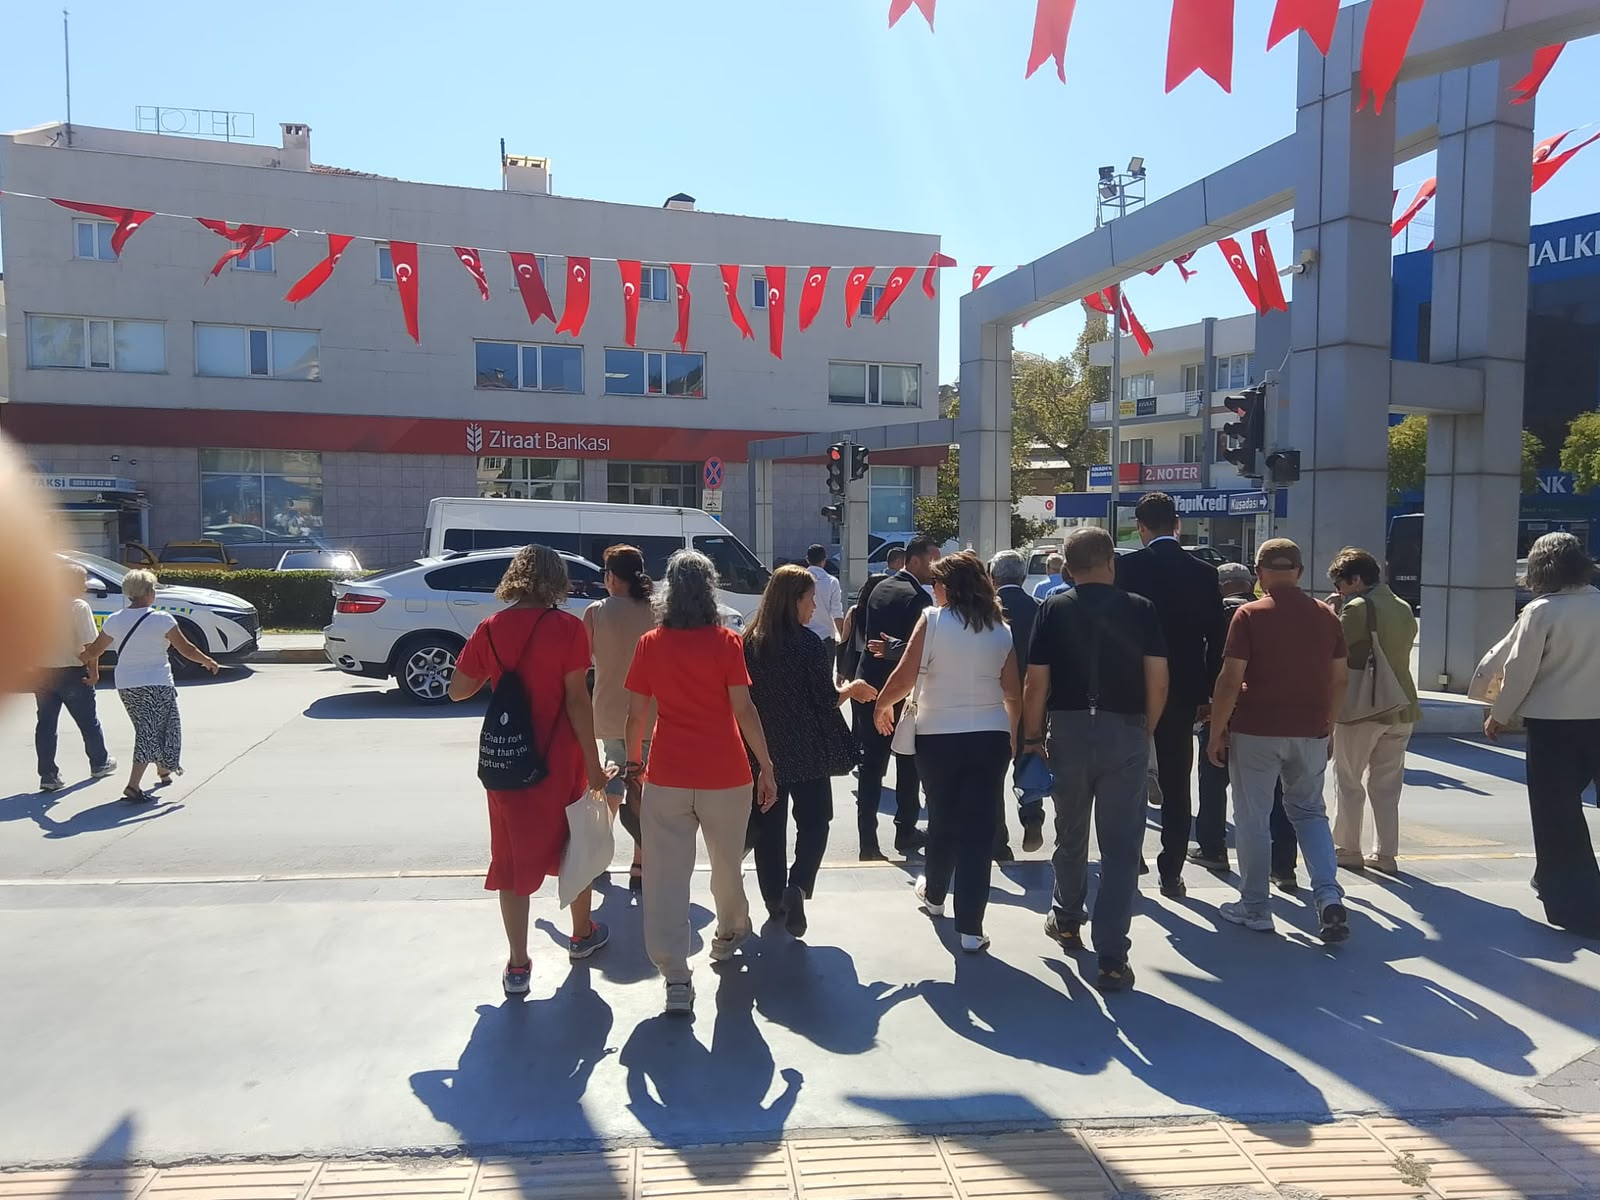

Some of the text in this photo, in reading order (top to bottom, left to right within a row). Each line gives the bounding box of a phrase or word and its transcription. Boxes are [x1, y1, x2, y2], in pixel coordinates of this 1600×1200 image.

[488, 430, 611, 452] Ziraat Bankası
[1536, 475, 1567, 493] NK
[1230, 497, 1259, 511] Kuşadası
[497, 747, 515, 757] than
